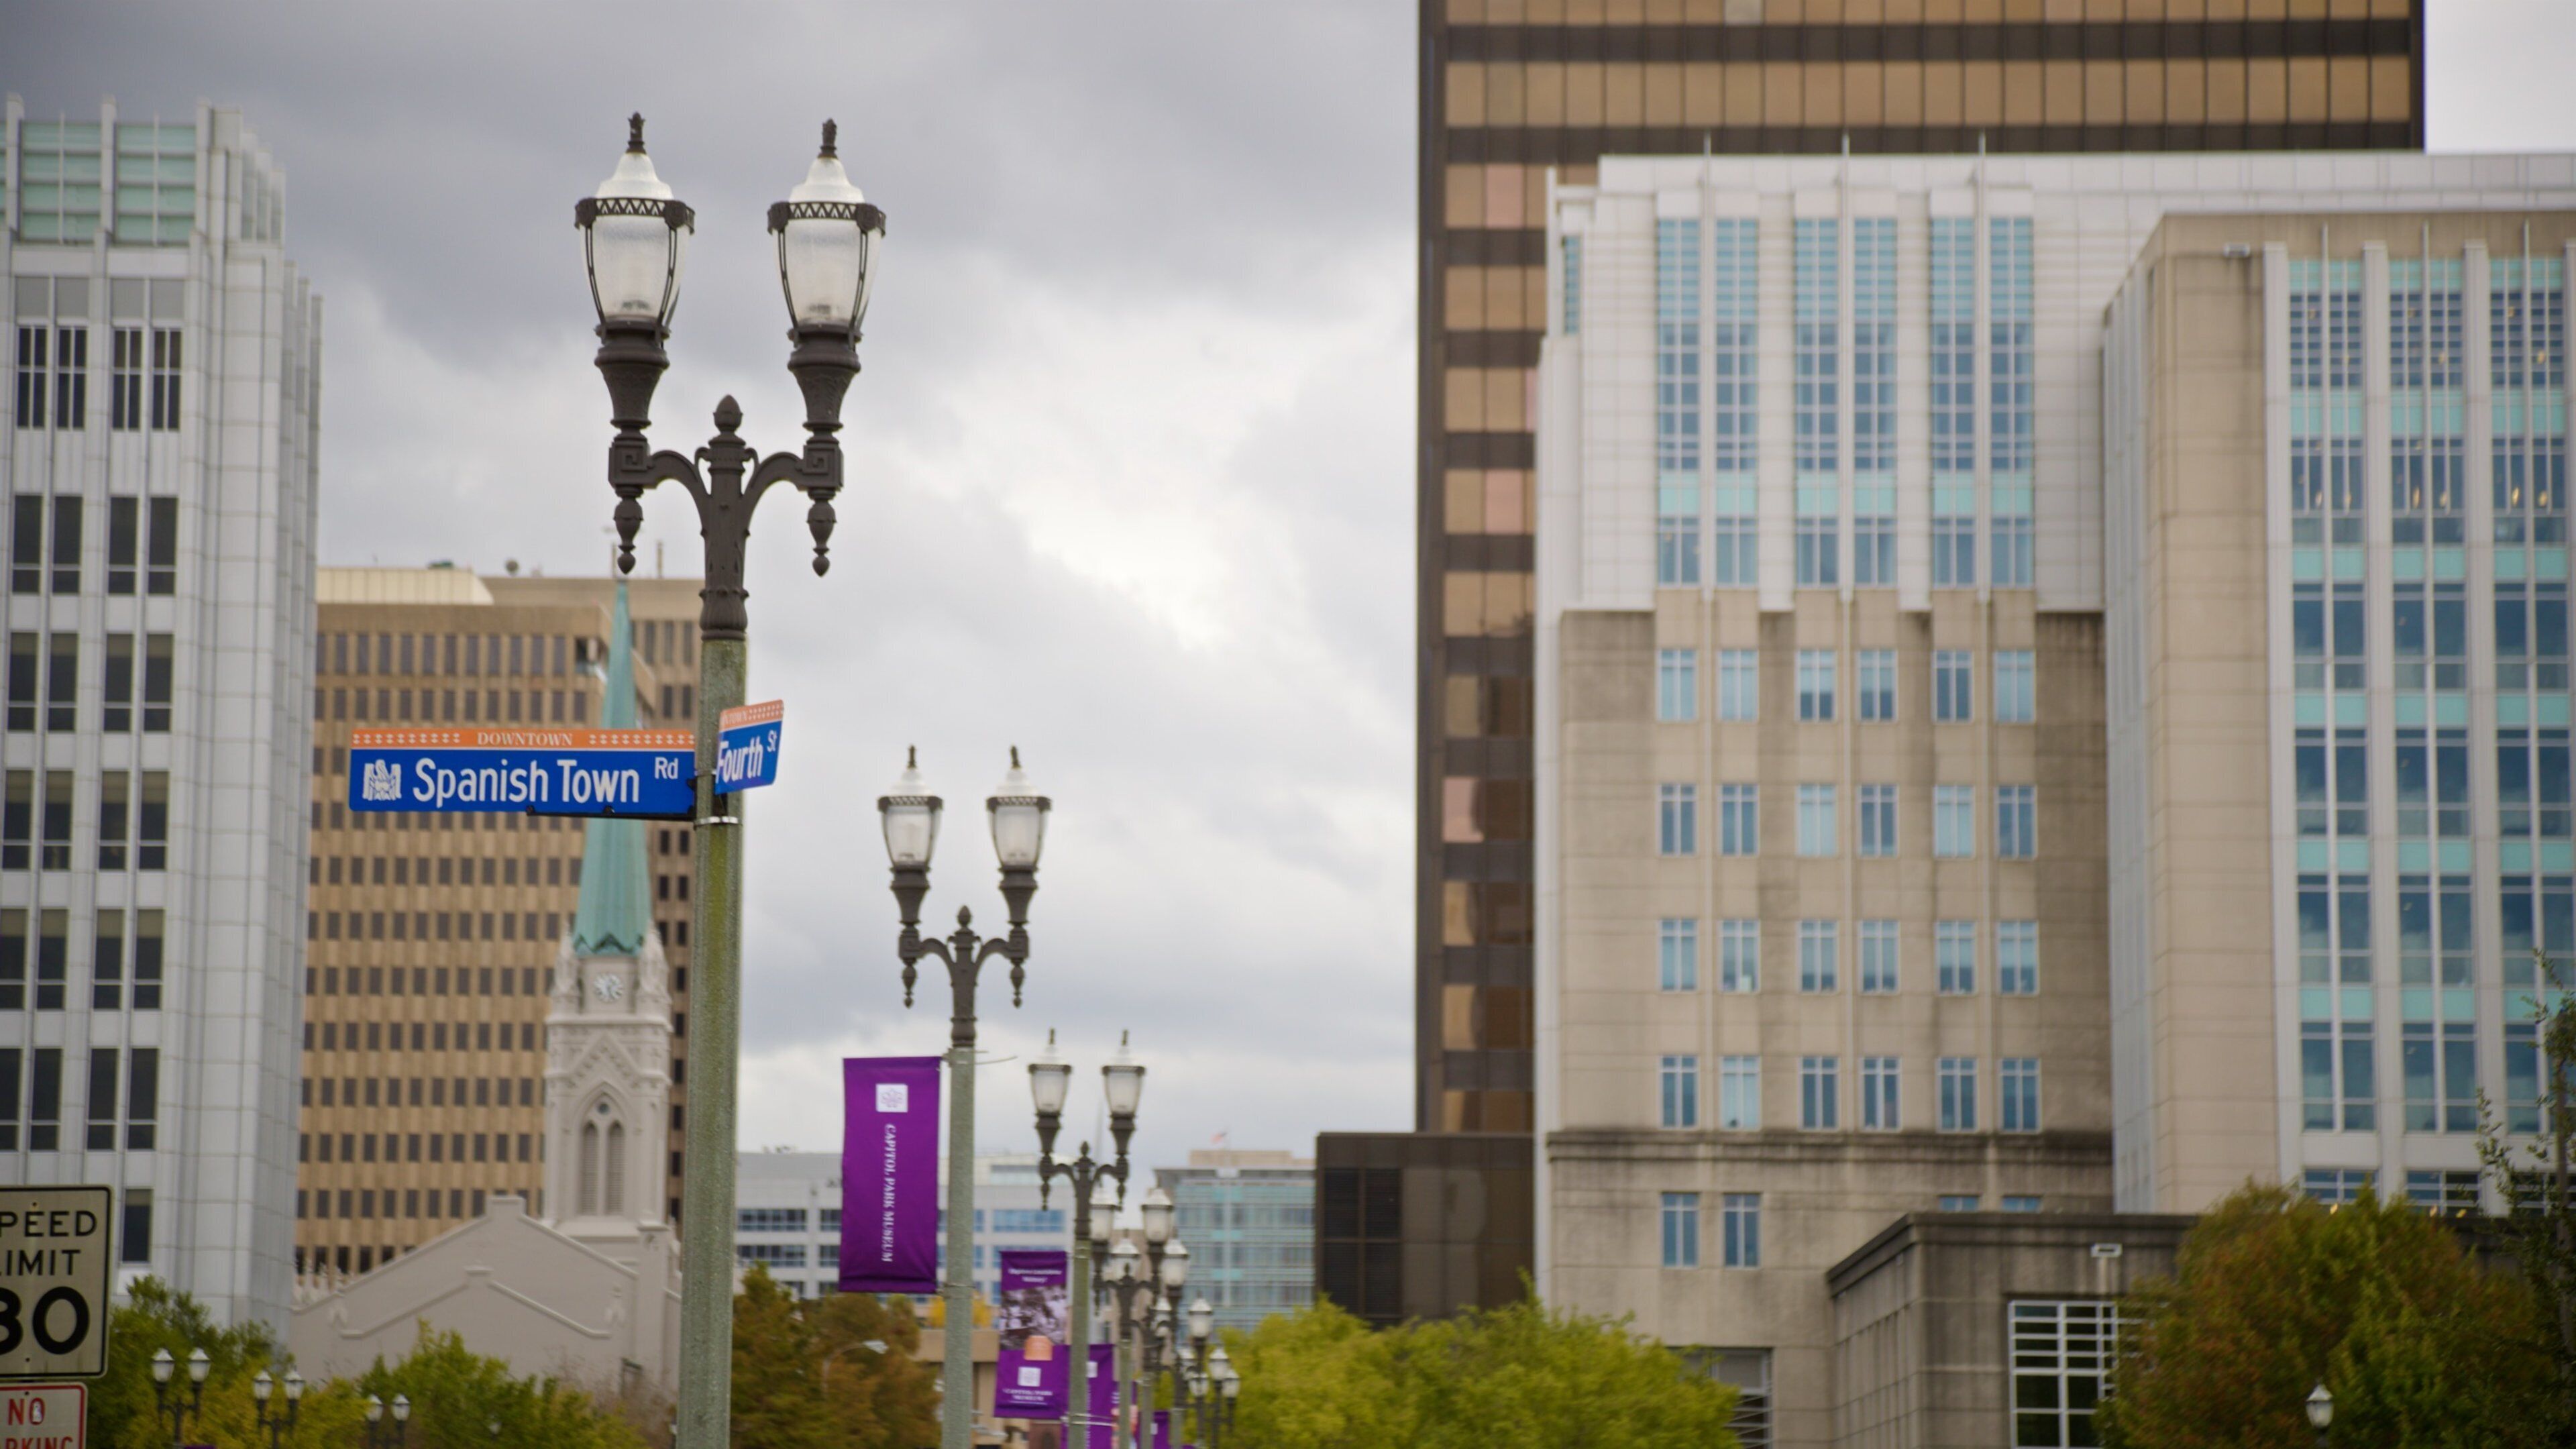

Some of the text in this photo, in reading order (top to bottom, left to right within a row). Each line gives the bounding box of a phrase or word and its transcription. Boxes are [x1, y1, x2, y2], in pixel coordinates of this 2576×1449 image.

[476, 732, 573, 746] DOWNTOWN
[715, 729, 777, 784] Fourth St
[413, 756, 679, 808] Spanish Town Rd
[881, 1123, 897, 1263] CAPITOL PARK MUSEUM
[0, 1210, 97, 1237] PEED
[0, 1249, 80, 1276] IMIT
[8, 1397, 45, 1426] NO
